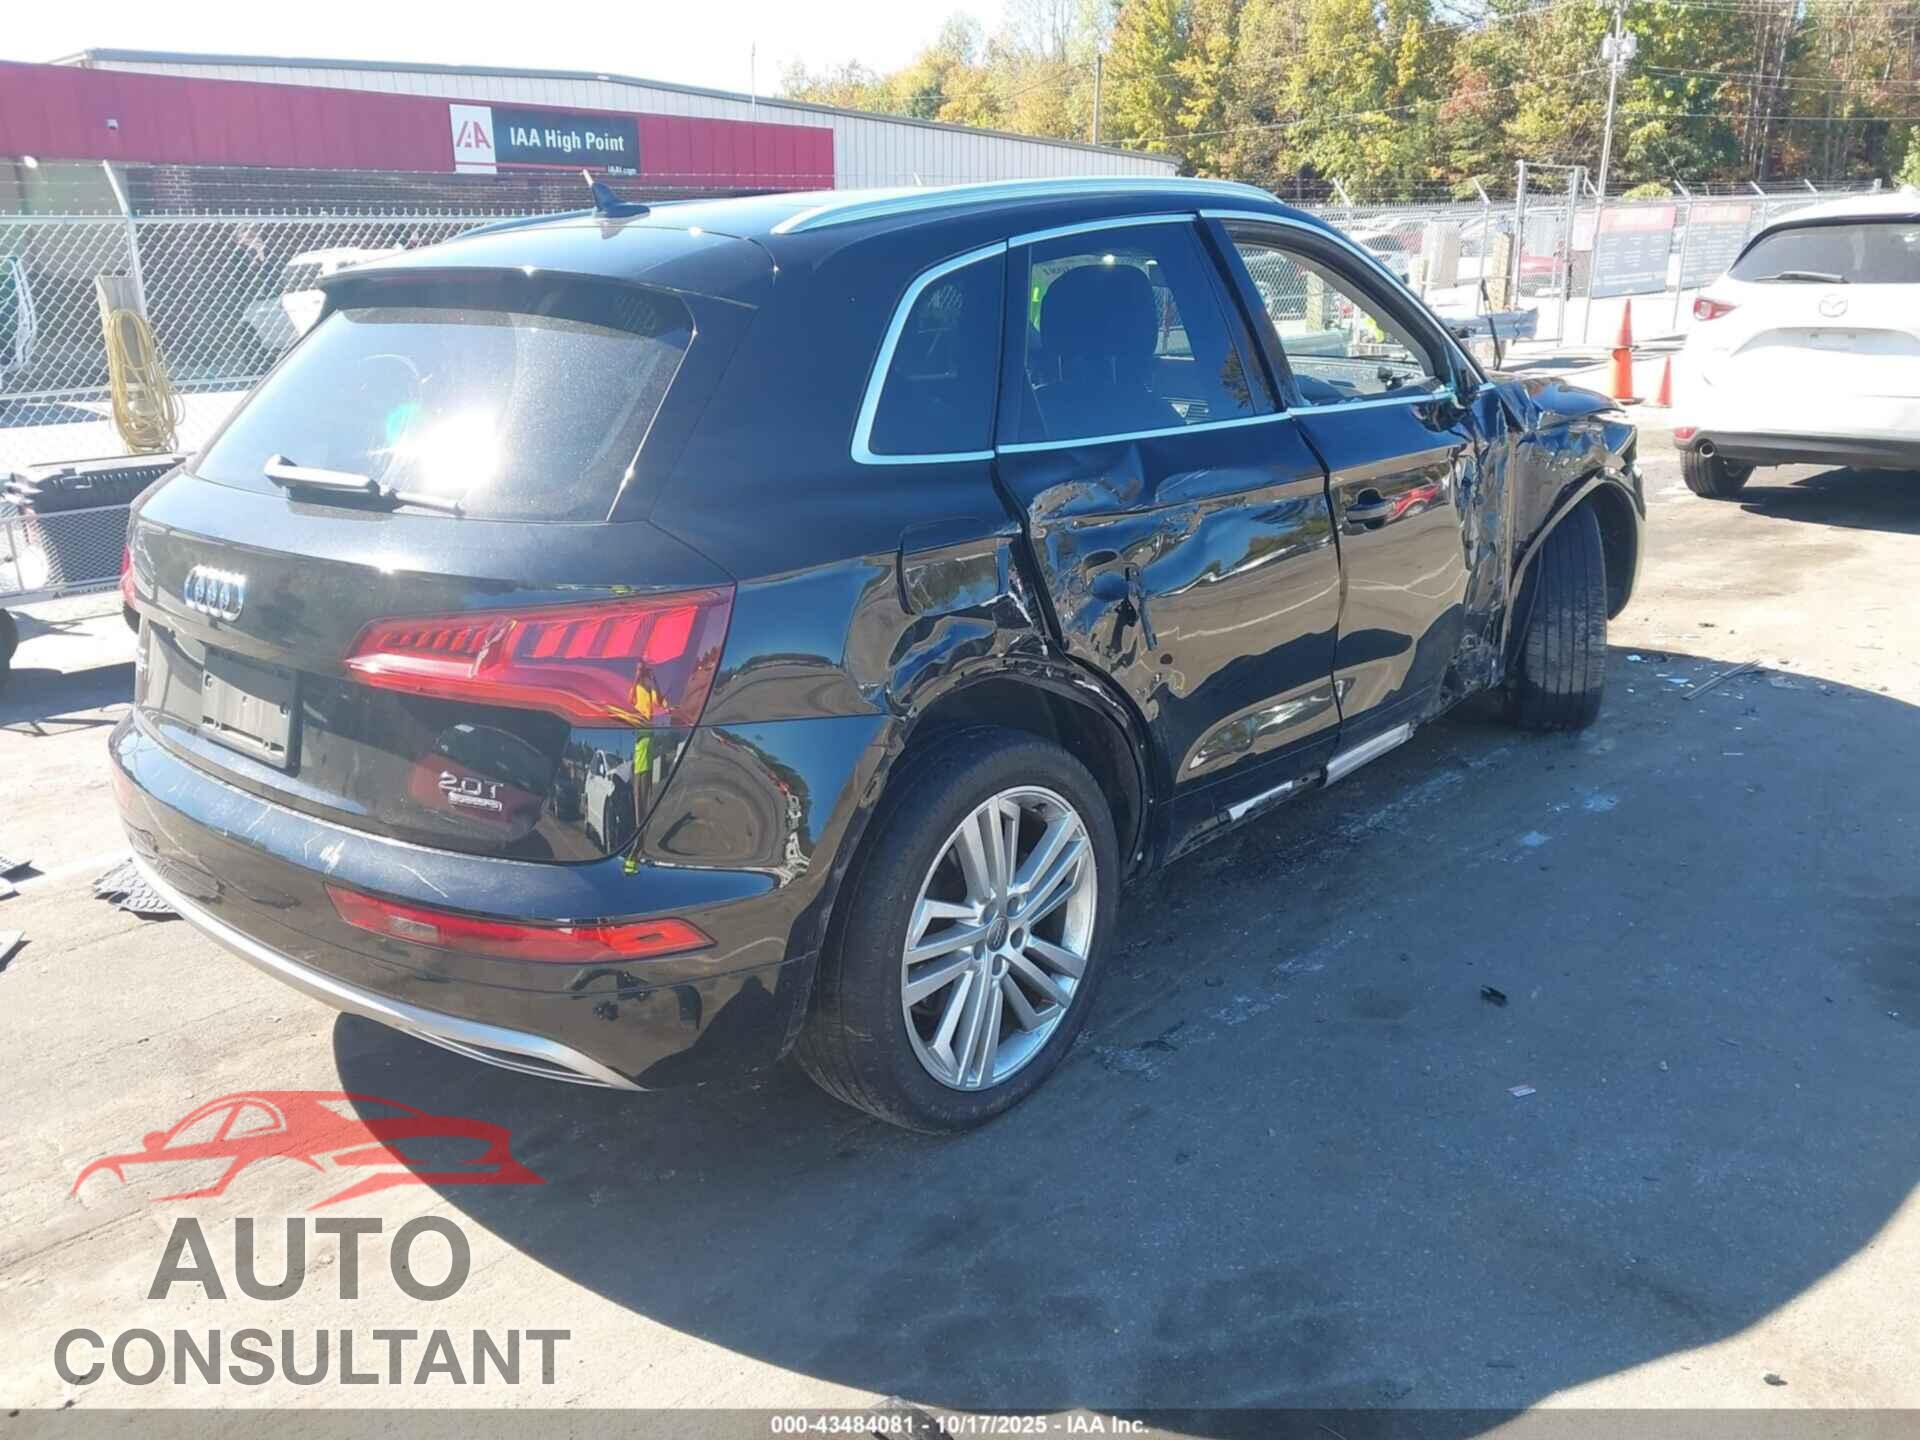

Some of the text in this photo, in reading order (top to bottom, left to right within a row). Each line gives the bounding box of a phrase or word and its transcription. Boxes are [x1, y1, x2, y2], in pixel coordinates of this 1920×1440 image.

[509, 127, 625, 153] IAA High Point
[438, 769, 504, 799] 2.0T
